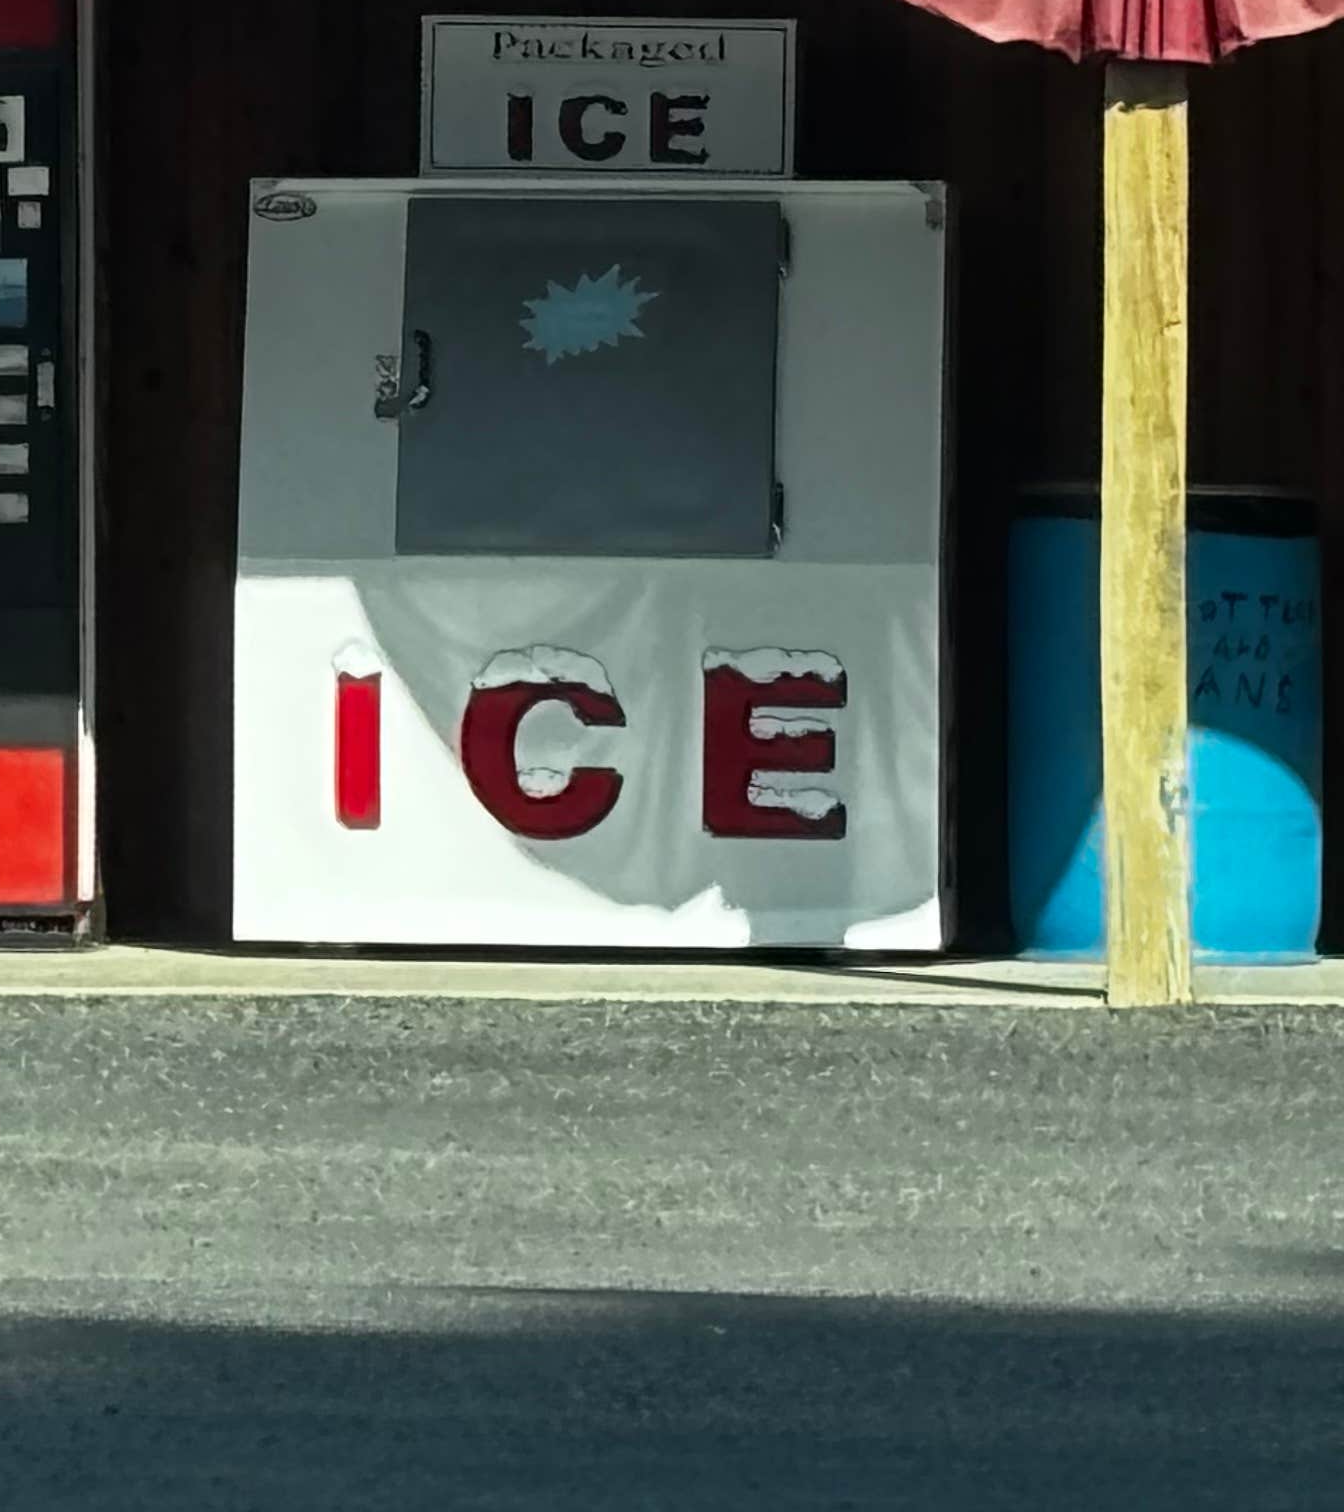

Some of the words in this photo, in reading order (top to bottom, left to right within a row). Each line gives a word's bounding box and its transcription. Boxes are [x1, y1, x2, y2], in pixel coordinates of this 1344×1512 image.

[493, 30, 727, 68] Packaged
[506, 90, 711, 164] ICE
[332, 643, 848, 841] ICE
